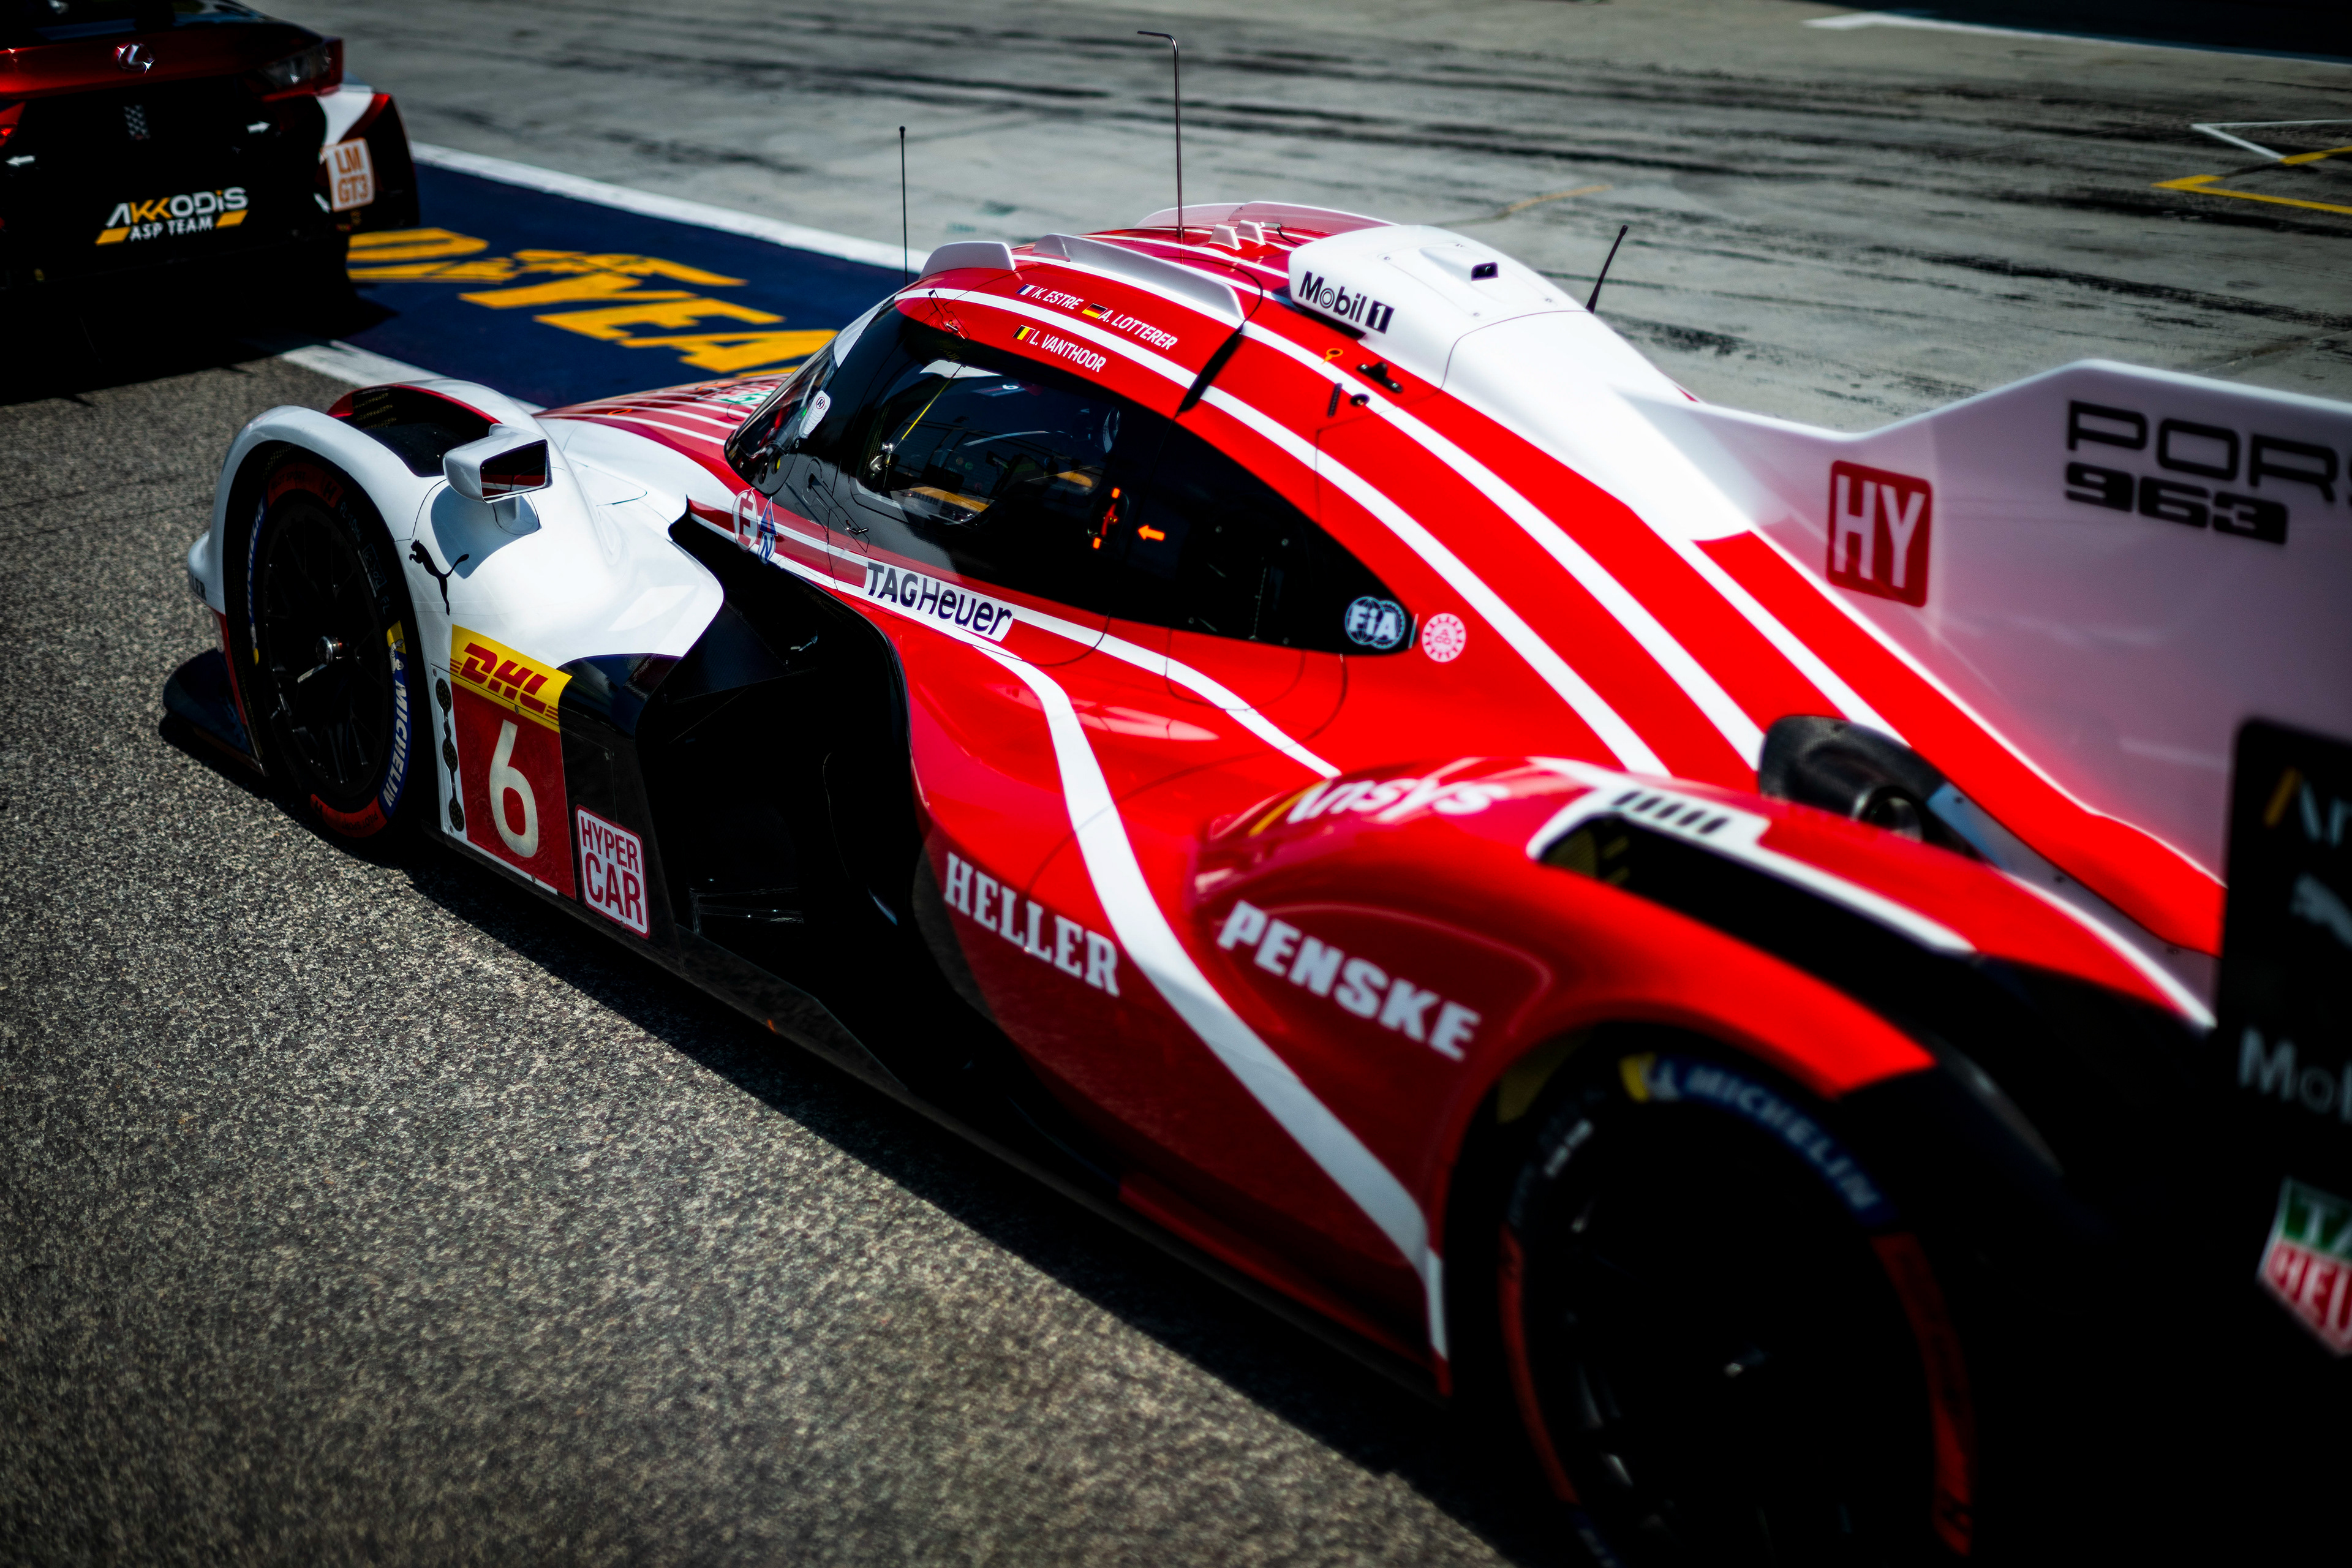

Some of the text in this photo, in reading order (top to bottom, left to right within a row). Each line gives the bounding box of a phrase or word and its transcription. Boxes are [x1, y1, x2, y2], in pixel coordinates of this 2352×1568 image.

[334, 147, 362, 175] LM
[337, 175, 369, 206] GT3
[129, 216, 213, 242] ASP TEAM
[1042, 290, 1084, 311] ESTRE
[1110, 309, 1178, 351] LOTTERER
[1297, 270, 1368, 323] Mobil
[1041, 334, 1107, 373] VANTHOOR
[2068, 400, 2352, 503] POR
[737, 496, 754, 547] E
[1836, 473, 1926, 590] HY
[2065, 461, 2287, 545] 963
[458, 641, 548, 712] DHL
[383, 679, 409, 809] MICHELIN
[489, 719, 540, 858] 6
[1249, 777, 1510, 837] Ansys
[581, 815, 639, 873] HYPER
[584, 851, 645, 926] CAR
[943, 851, 1120, 997] HELLER
[1216, 899, 1482, 1063] PENSKE
[1684, 1066, 1882, 1210] MICHELIN
